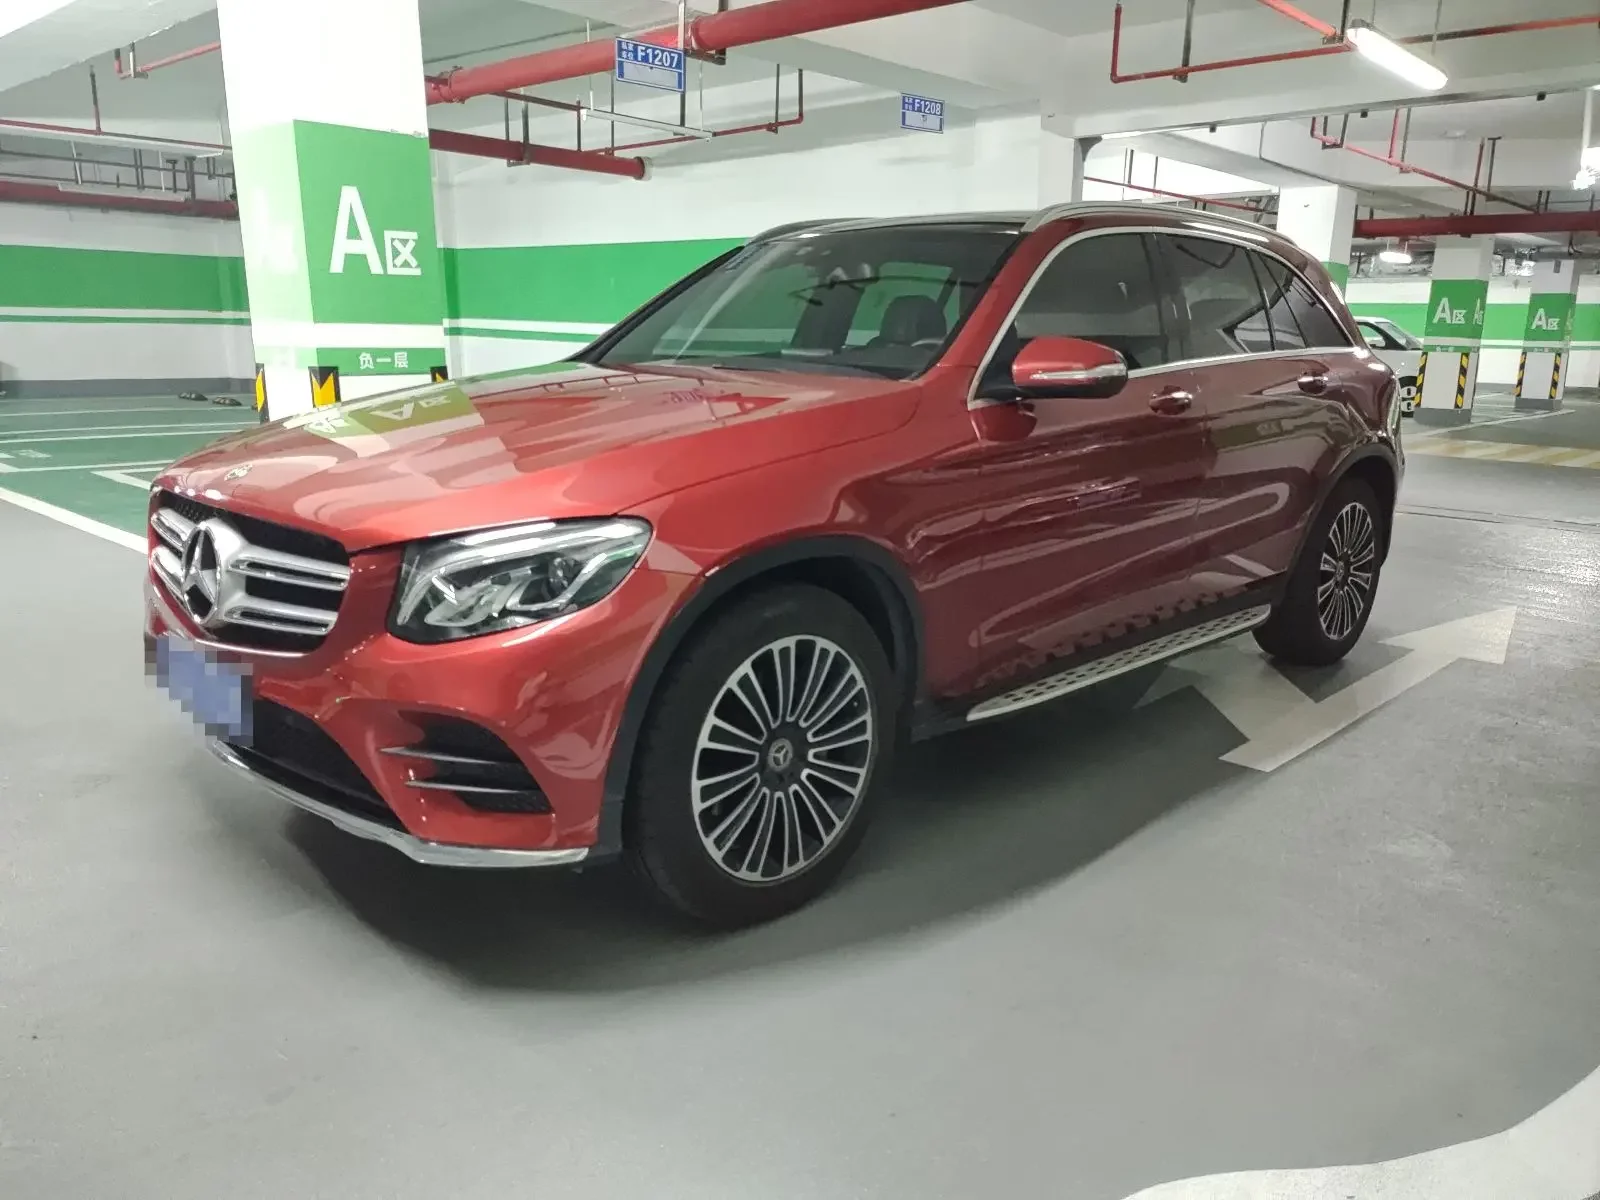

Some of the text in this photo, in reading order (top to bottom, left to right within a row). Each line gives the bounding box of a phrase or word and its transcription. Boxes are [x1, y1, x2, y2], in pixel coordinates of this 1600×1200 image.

[637, 45, 679, 68] F1207
[914, 98, 941, 115] F1208
[329, 185, 422, 276] A区
[1432, 297, 1467, 324] A区
[1530, 307, 1560, 330] A区
[358, 351, 409, 370] 负一层
